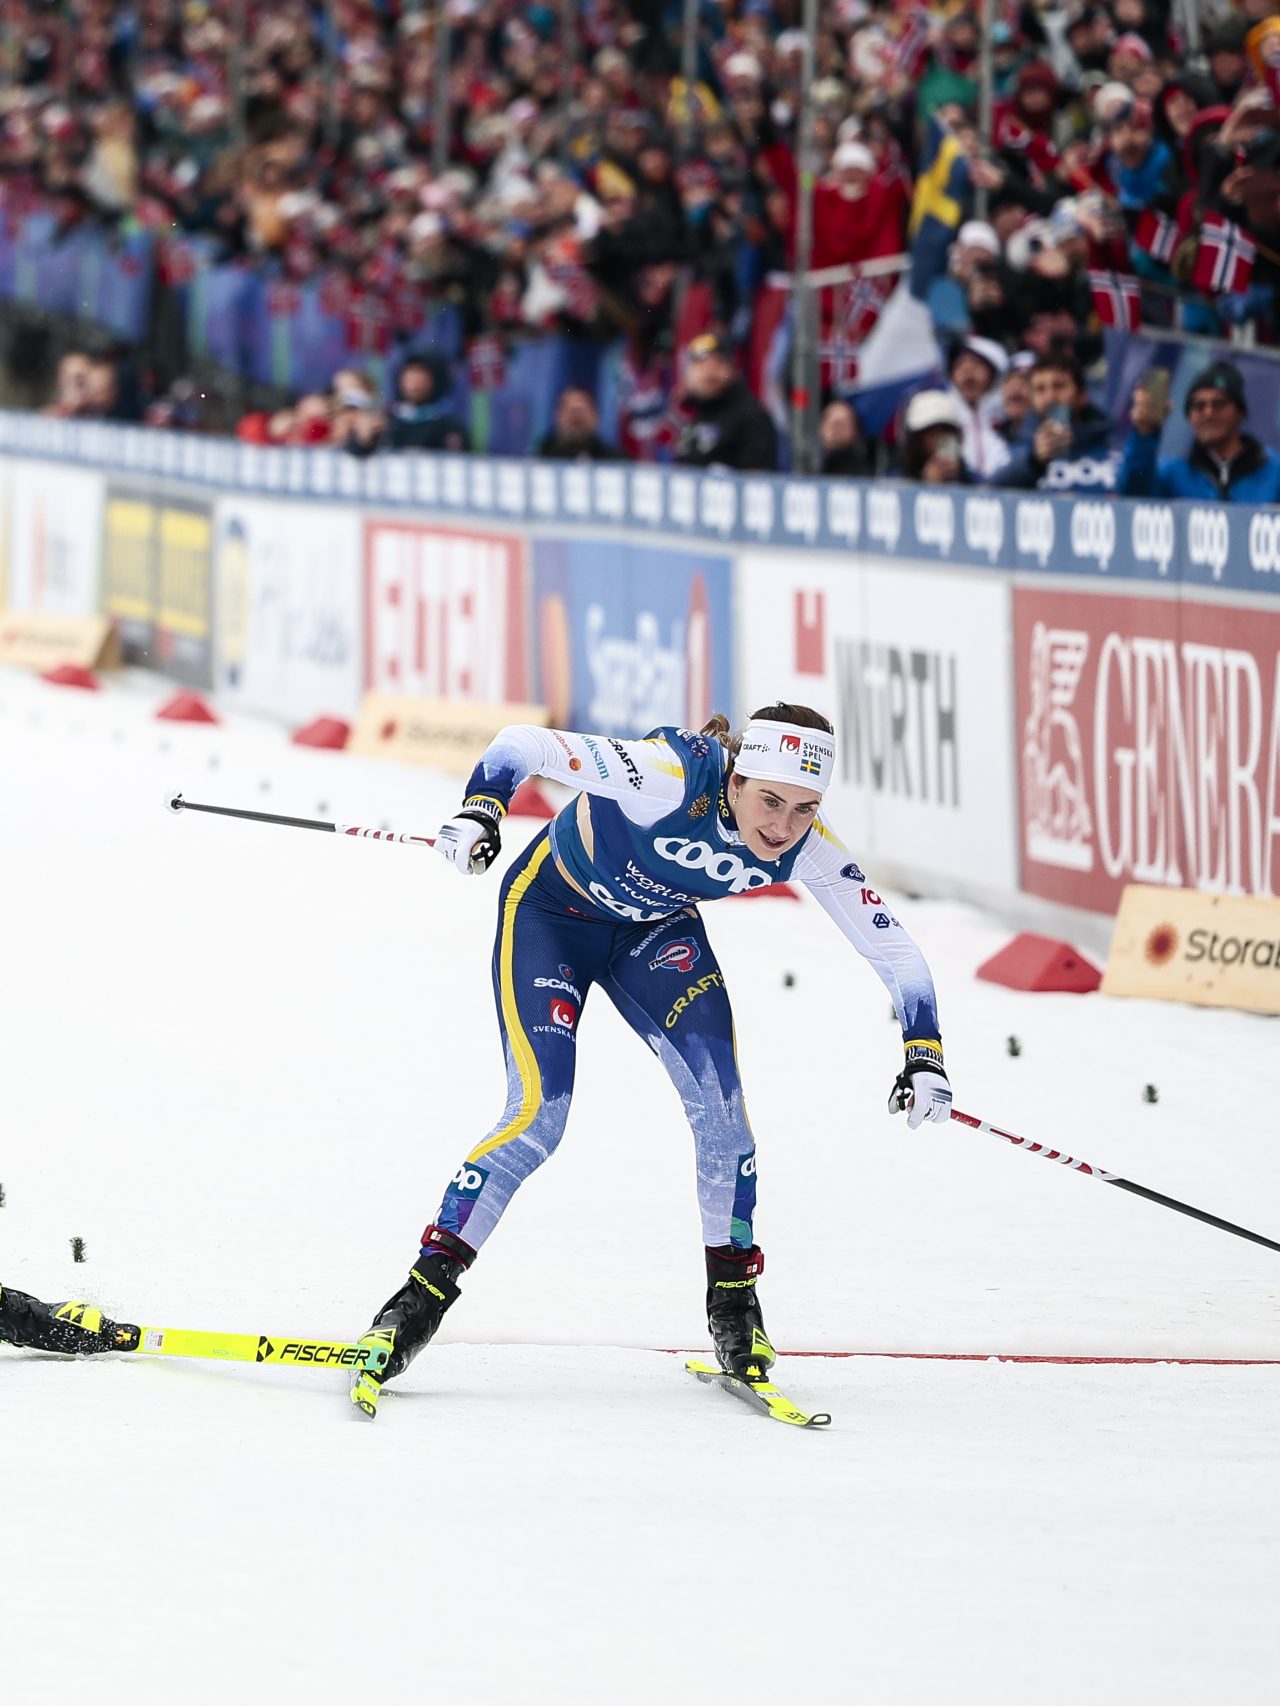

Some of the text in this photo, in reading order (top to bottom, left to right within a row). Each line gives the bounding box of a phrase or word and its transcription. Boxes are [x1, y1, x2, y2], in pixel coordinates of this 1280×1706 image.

[1248, 512, 1280, 574] coo
[578, 733, 610, 780] olksam
[607, 738, 639, 775] CRAFT
[803, 742, 833, 758] SVENSKA
[803, 750, 822, 762] SPEL
[654, 837, 772, 893] coop
[861, 888, 886, 906] IC
[649, 948, 688, 968] Thermia
[1184, 927, 1280, 970] Stora
[665, 973, 719, 1028] CRAFT
[532, 1025, 571, 1039] SVENSKA
[280, 1342, 371, 1366] FISCHER
